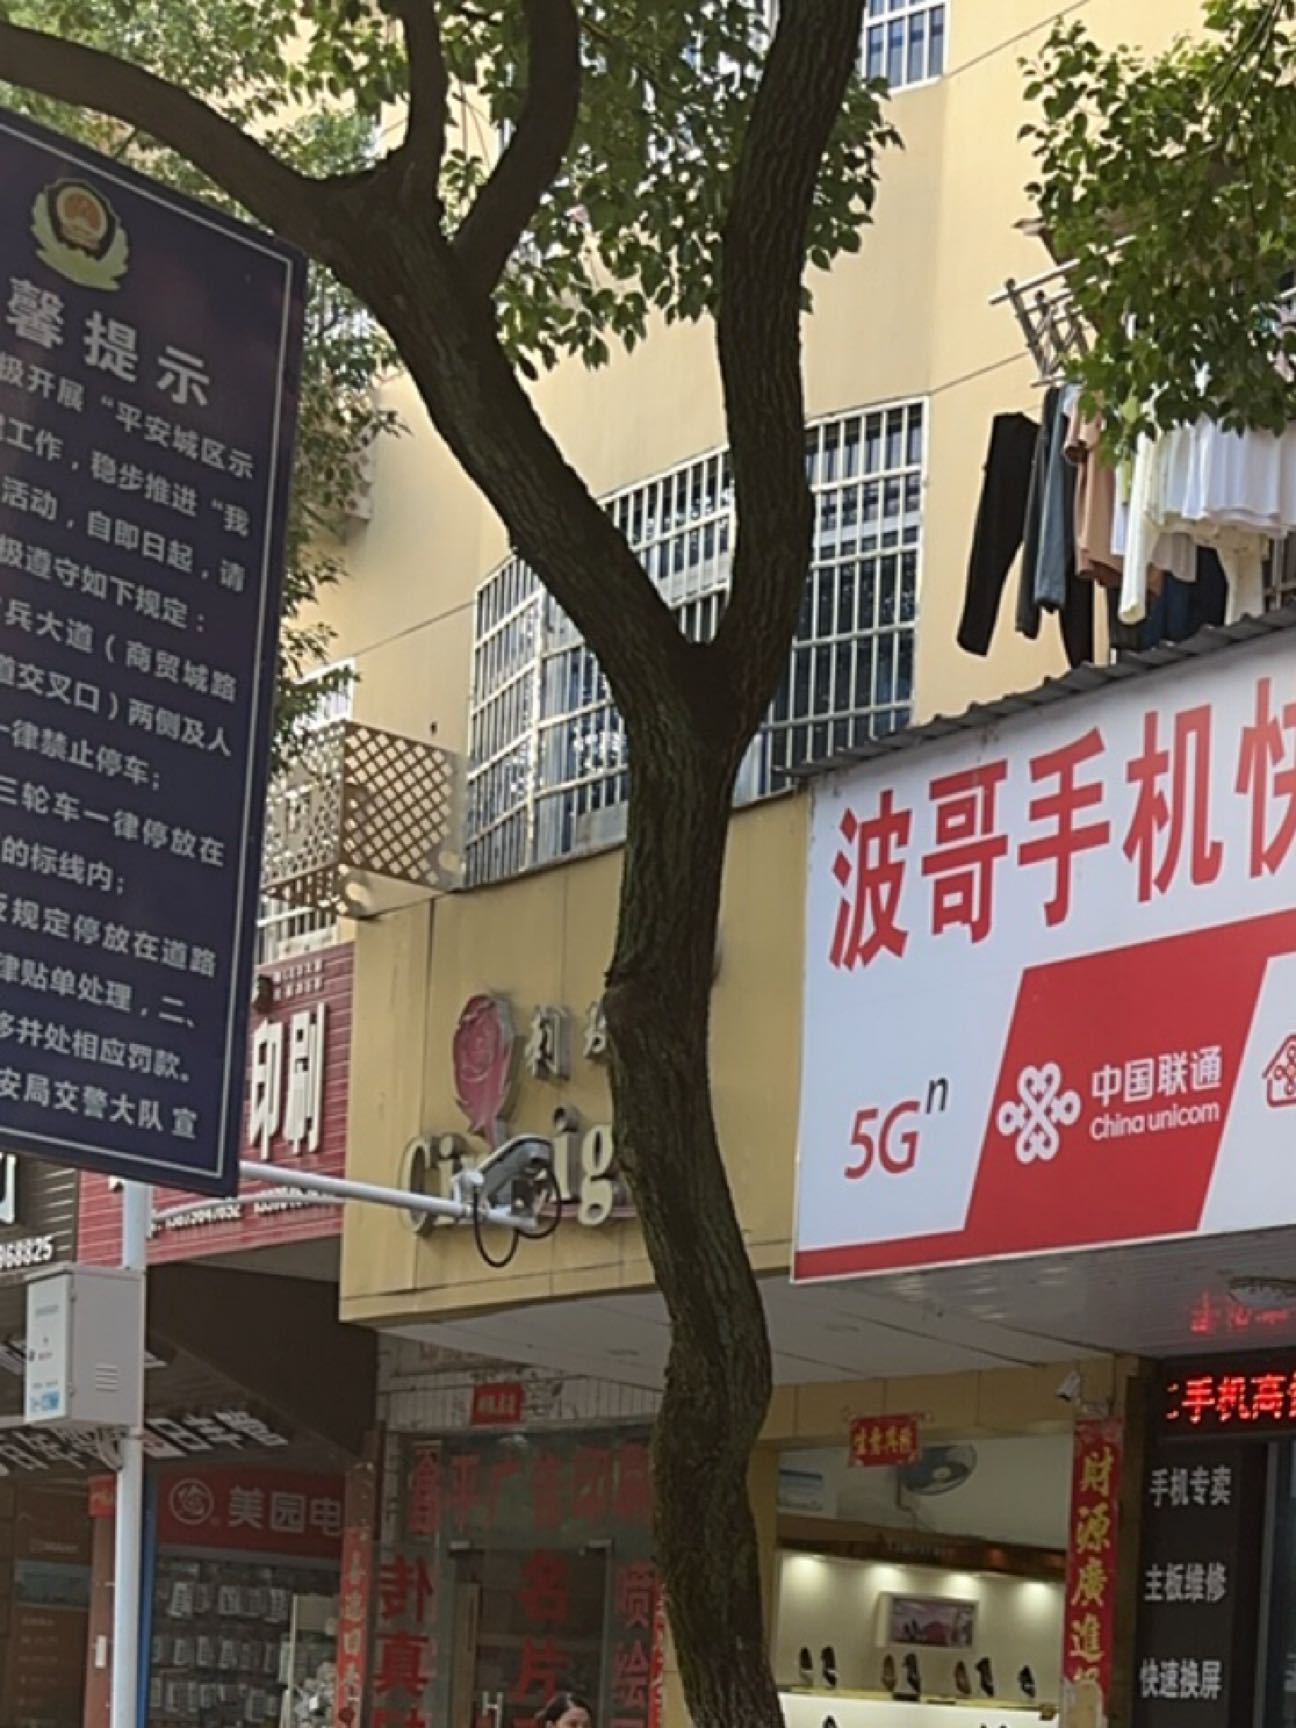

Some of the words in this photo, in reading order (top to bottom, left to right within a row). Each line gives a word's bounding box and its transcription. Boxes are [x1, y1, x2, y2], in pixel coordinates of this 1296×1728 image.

[7, 277, 210, 406] 馨提示
[0, 412, 250, 537] 工作，稳步推进“我
[0, 893, 216, 978] 规定停放在道路
[1091, 1046, 1223, 1108] 中国联通
[1091, 1119, 1147, 1142] China
[1150, 1099, 1220, 1134] unicom
[1150, 1465, 1232, 1507] 手机专卖
[1144, 1562, 1227, 1603] 主板维修
[1139, 1657, 1223, 1700] 快速换屏
